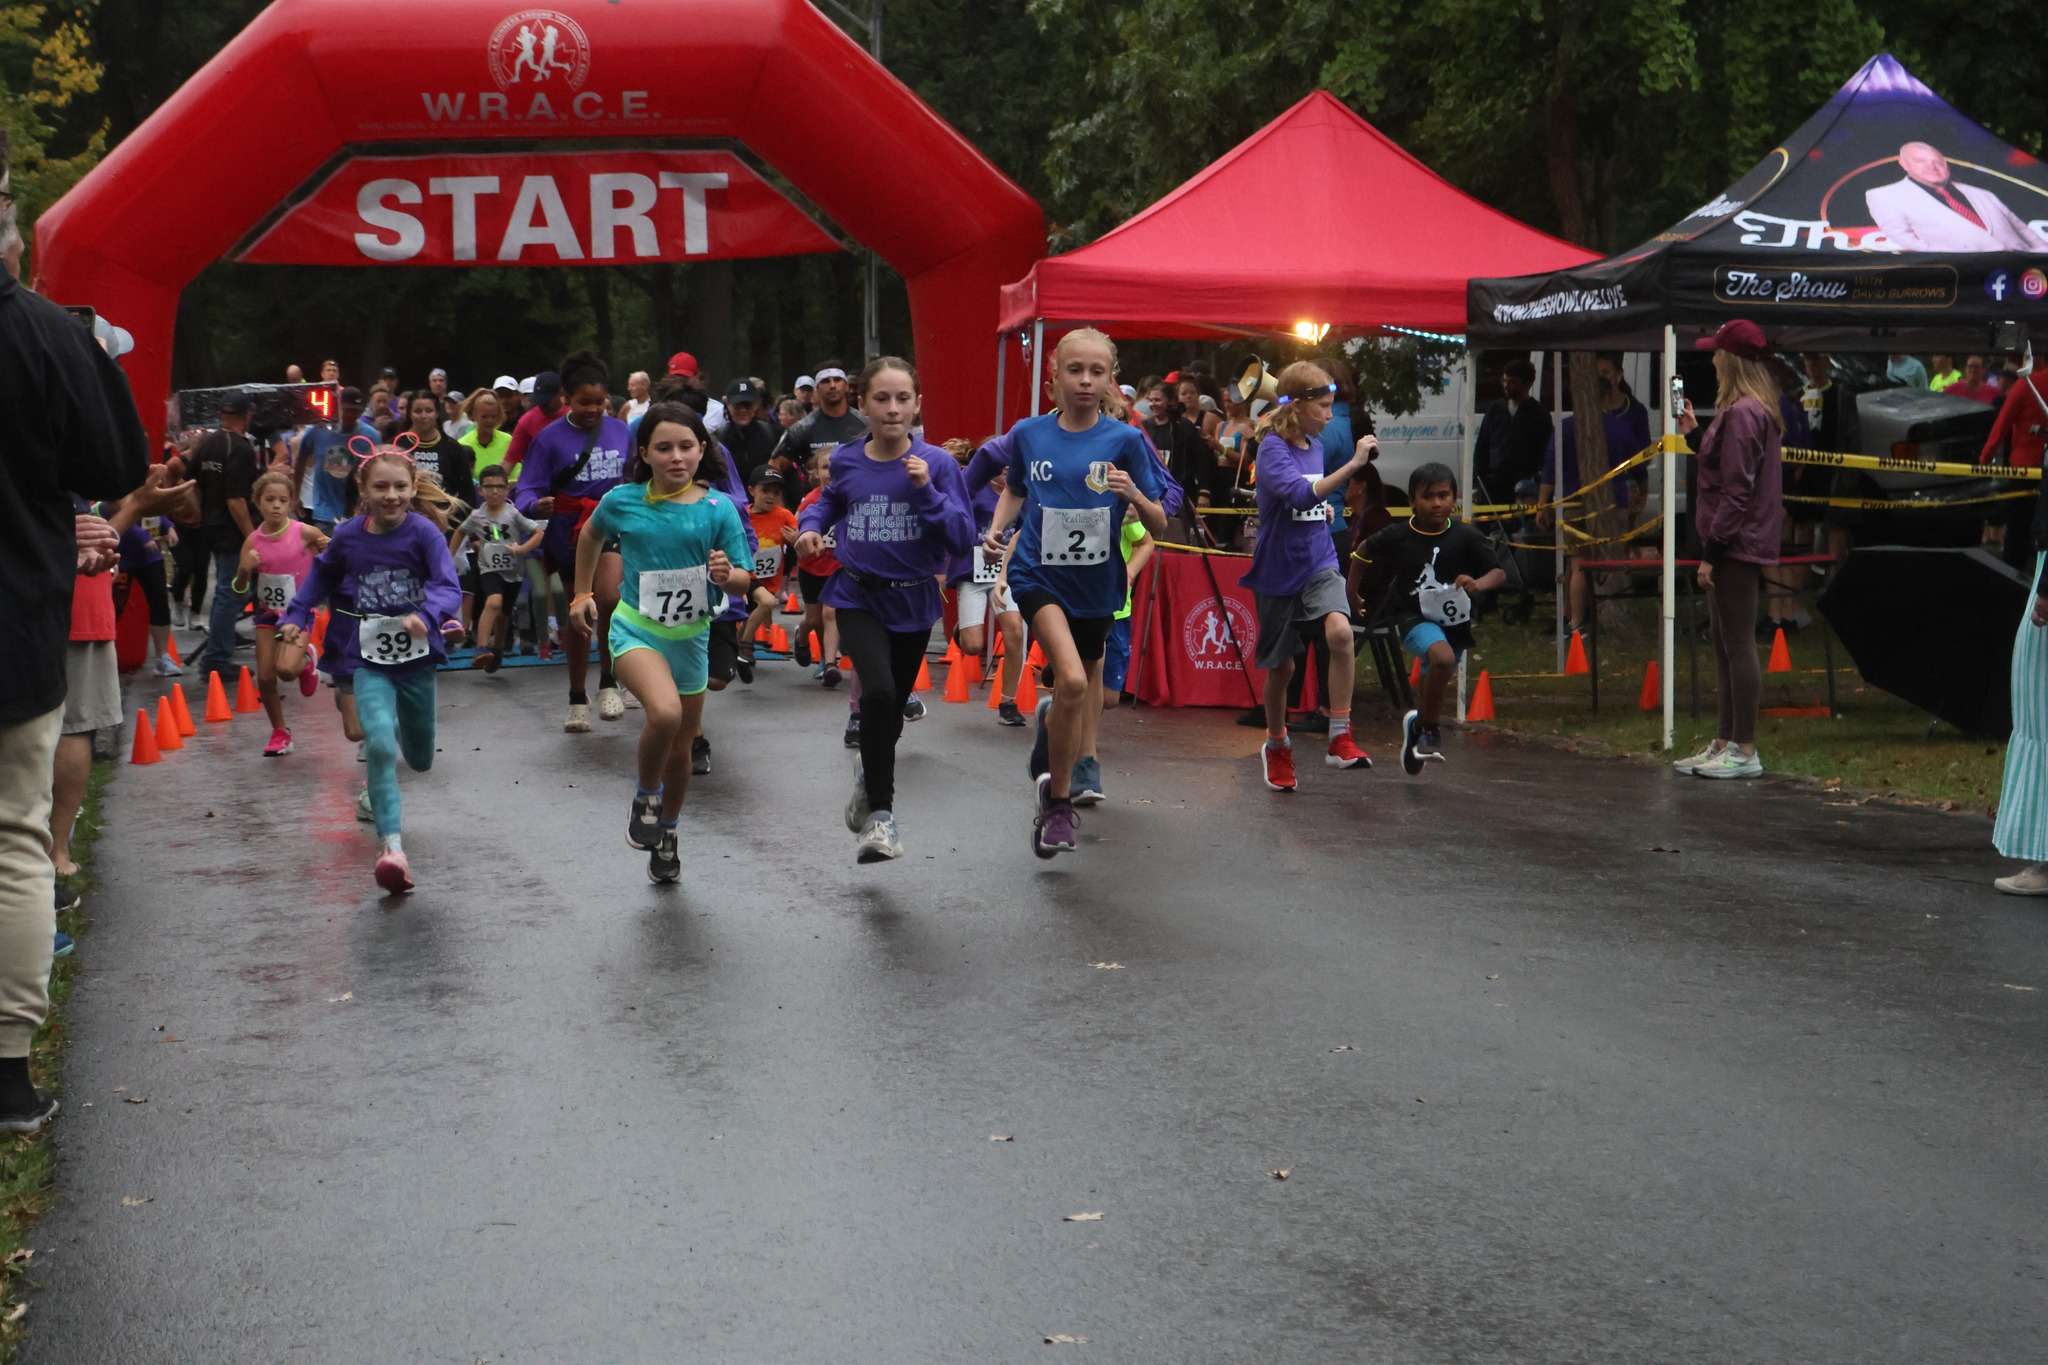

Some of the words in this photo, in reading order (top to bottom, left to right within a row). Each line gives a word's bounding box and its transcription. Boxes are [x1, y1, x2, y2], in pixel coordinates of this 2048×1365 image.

[421, 90, 662, 121] W.R.A.C.E.
[354, 170, 729, 262] START
[1726, 271, 1773, 297] The
[1776, 272, 1847, 302] Show
[1888, 287, 1946, 299] BURROWS
[311, 391, 329, 416] 4
[1786, 448, 1844, 464] CAUTION
[1030, 460, 1053, 482] KC
[1878, 457, 1936, 472] CAUTION
[1970, 464, 2028, 477] CAUTION
[891, 503, 910, 515] UP
[1068, 530, 1086, 552] 2
[492, 553, 511, 565] 65
[755, 558, 774, 571] 52
[983, 558, 1003, 574] 45
[264, 586, 285, 602] 28
[656, 588, 693, 615] 72
[1443, 600, 1457, 617] 6
[376, 631, 412, 655] 39
[1194, 660, 1244, 670] W.R.A.C.E.
